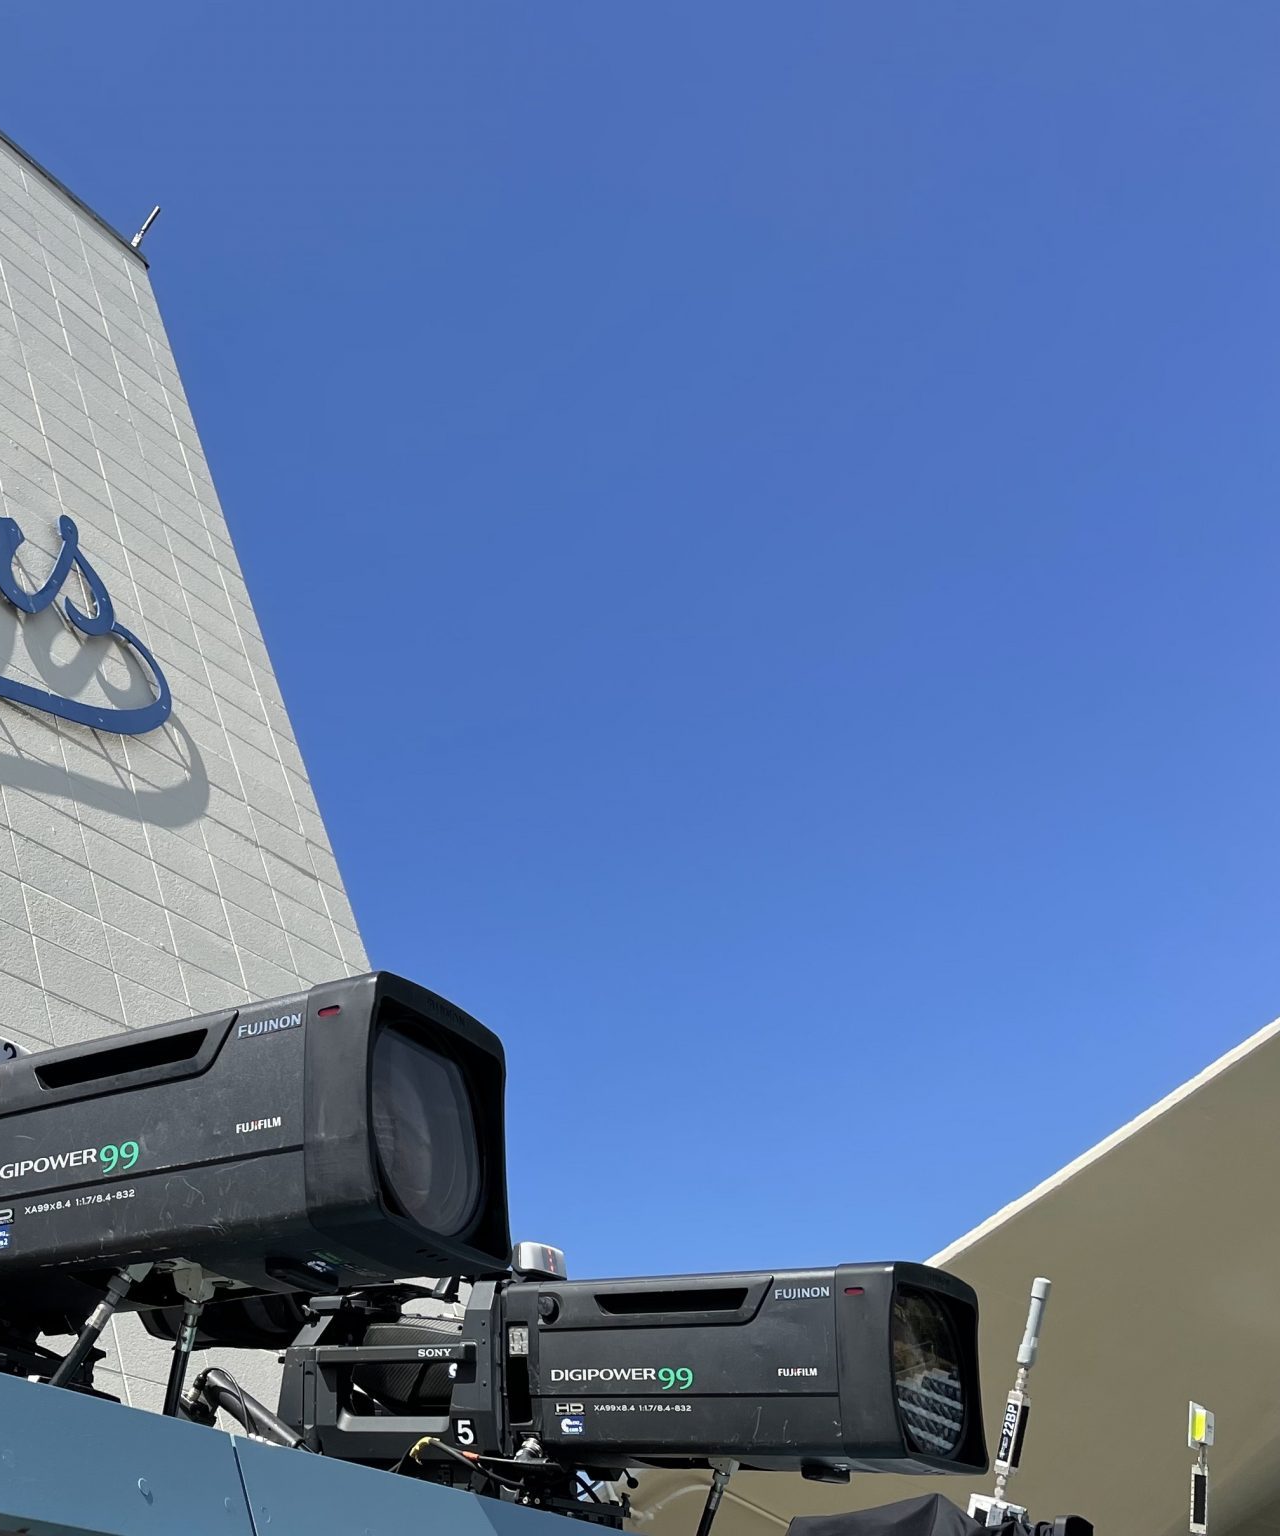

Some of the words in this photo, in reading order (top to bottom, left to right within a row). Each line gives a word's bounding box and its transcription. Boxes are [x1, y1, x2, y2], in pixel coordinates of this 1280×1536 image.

[238, 1013, 302, 1037] FUJINON
[774, 1286, 830, 1300] FUJINON
[417, 1348, 452, 1357] SONY
[555, 1402, 584, 1412] HD
[1002, 1404, 1017, 1437] 22BP
[457, 1419, 474, 1445] 5
